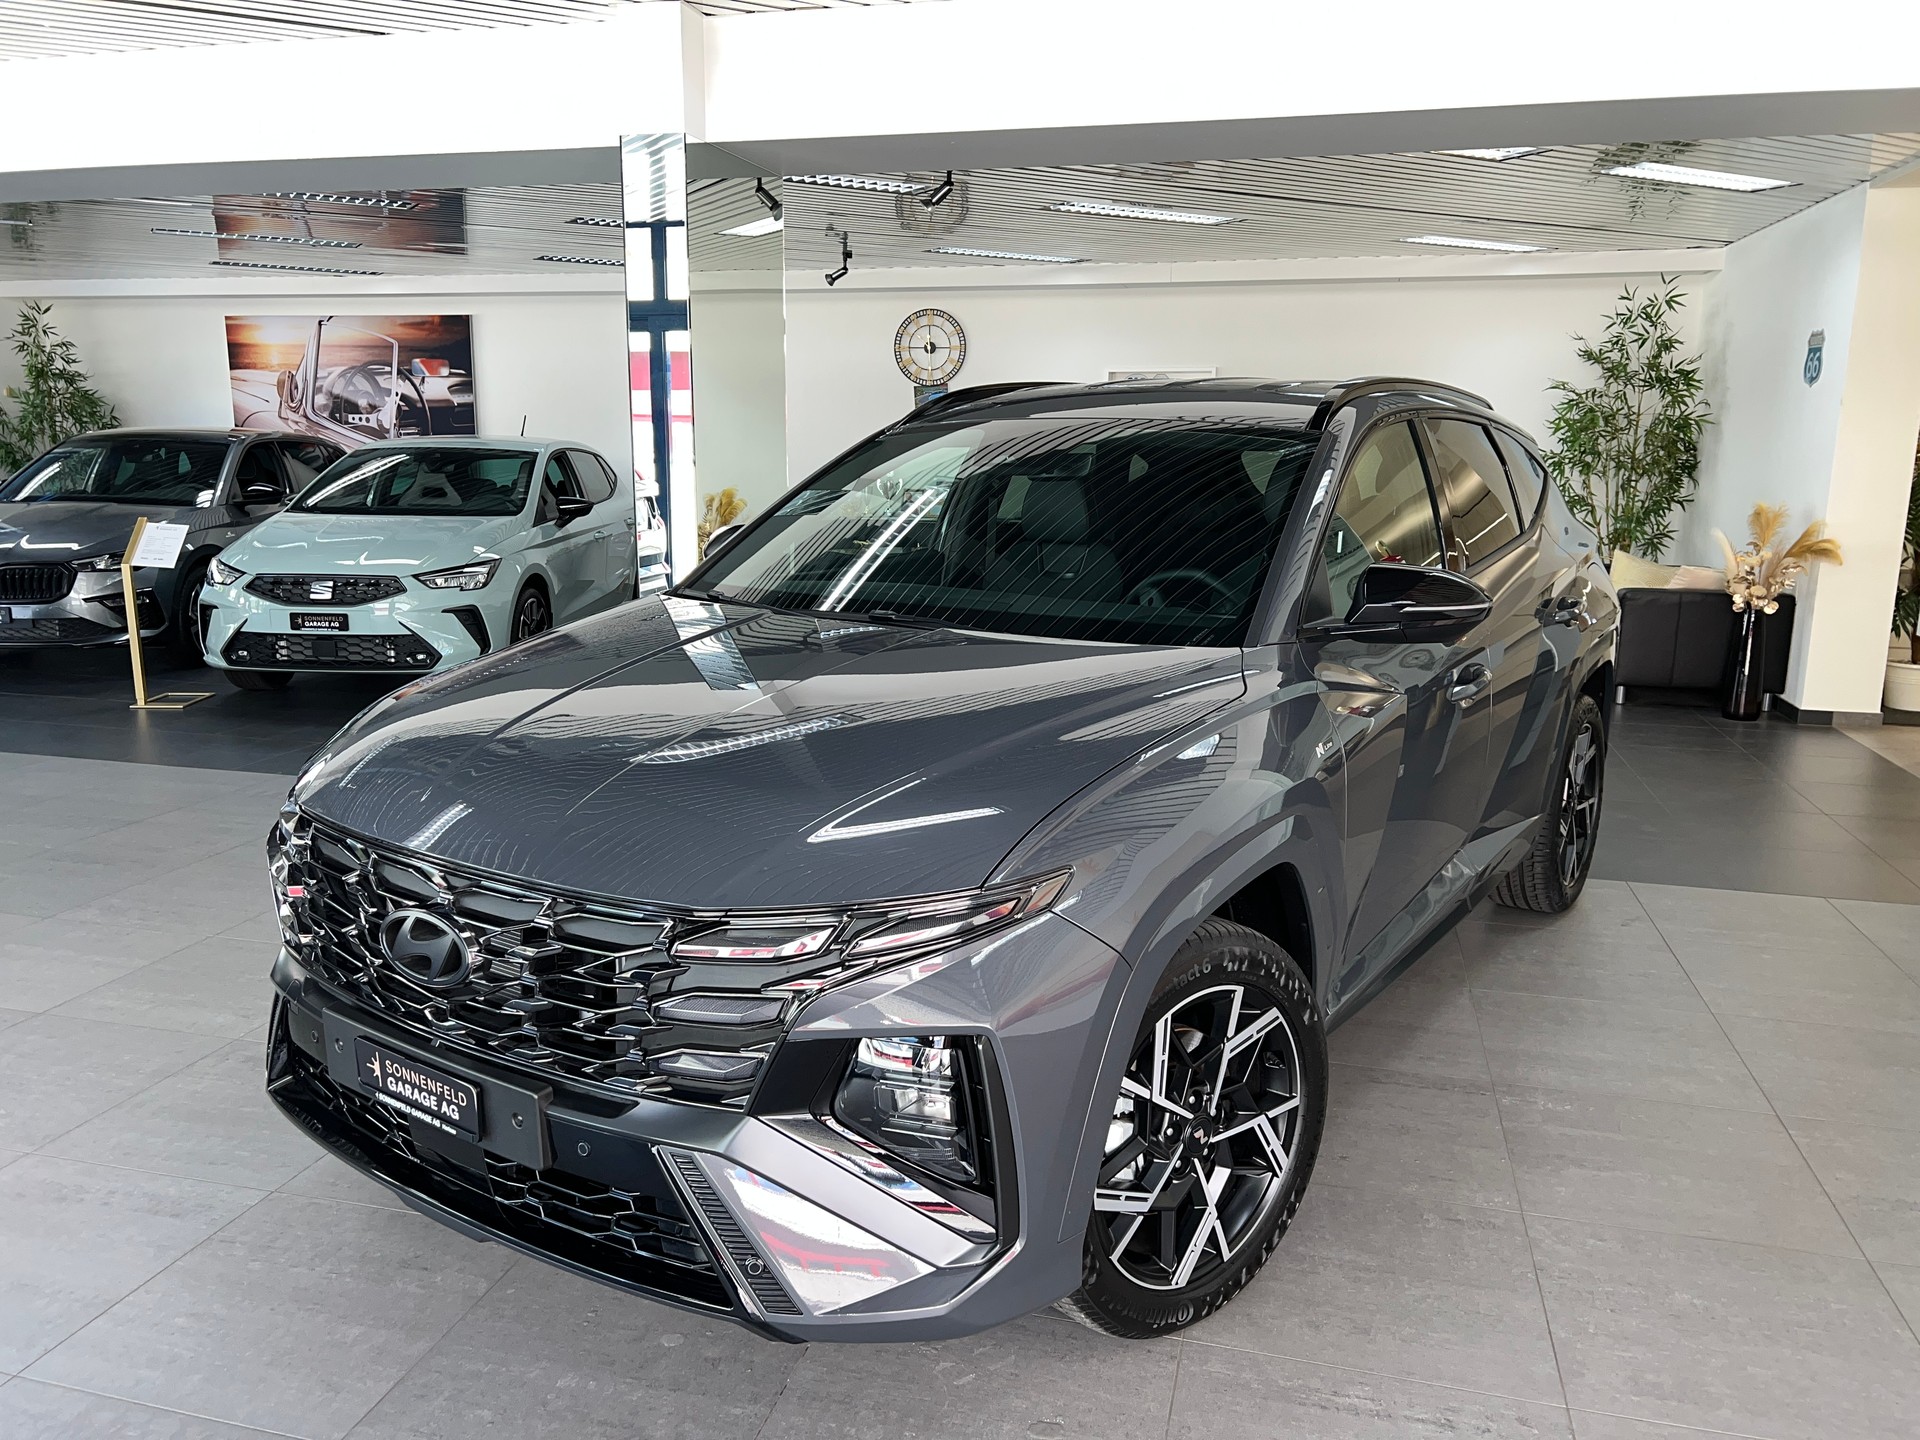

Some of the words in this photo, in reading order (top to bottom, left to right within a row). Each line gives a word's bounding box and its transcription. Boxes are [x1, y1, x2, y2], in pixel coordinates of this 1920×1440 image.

[1806, 351, 1820, 379] 66
[1202, 958, 1212, 974] 6
[385, 1059, 467, 1107] SONNENFELD
[387, 1076, 439, 1111] GARAGE
[441, 1101, 460, 1121] AG
